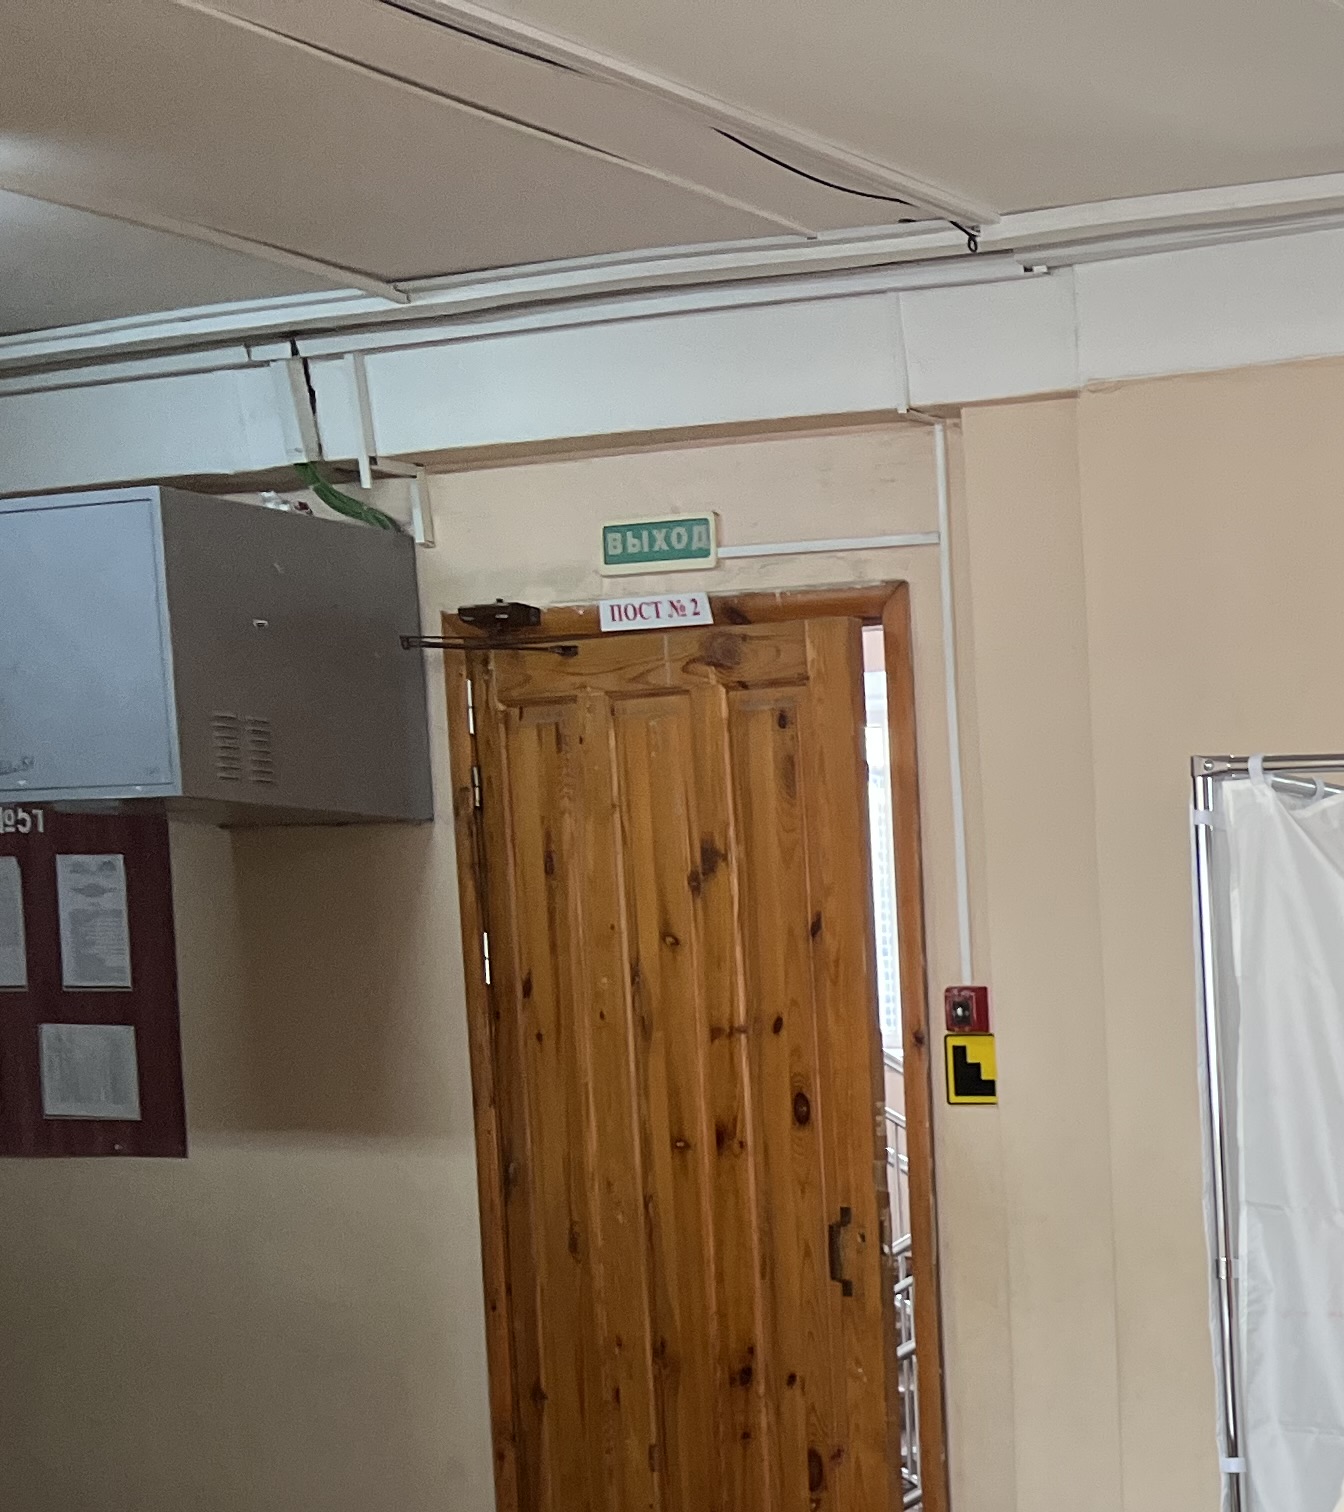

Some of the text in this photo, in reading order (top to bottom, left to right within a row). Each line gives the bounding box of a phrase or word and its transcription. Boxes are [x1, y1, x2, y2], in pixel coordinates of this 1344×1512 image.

[607, 525, 710, 555] ВЫХОД
[609, 598, 701, 622] ПОСТ № 2
